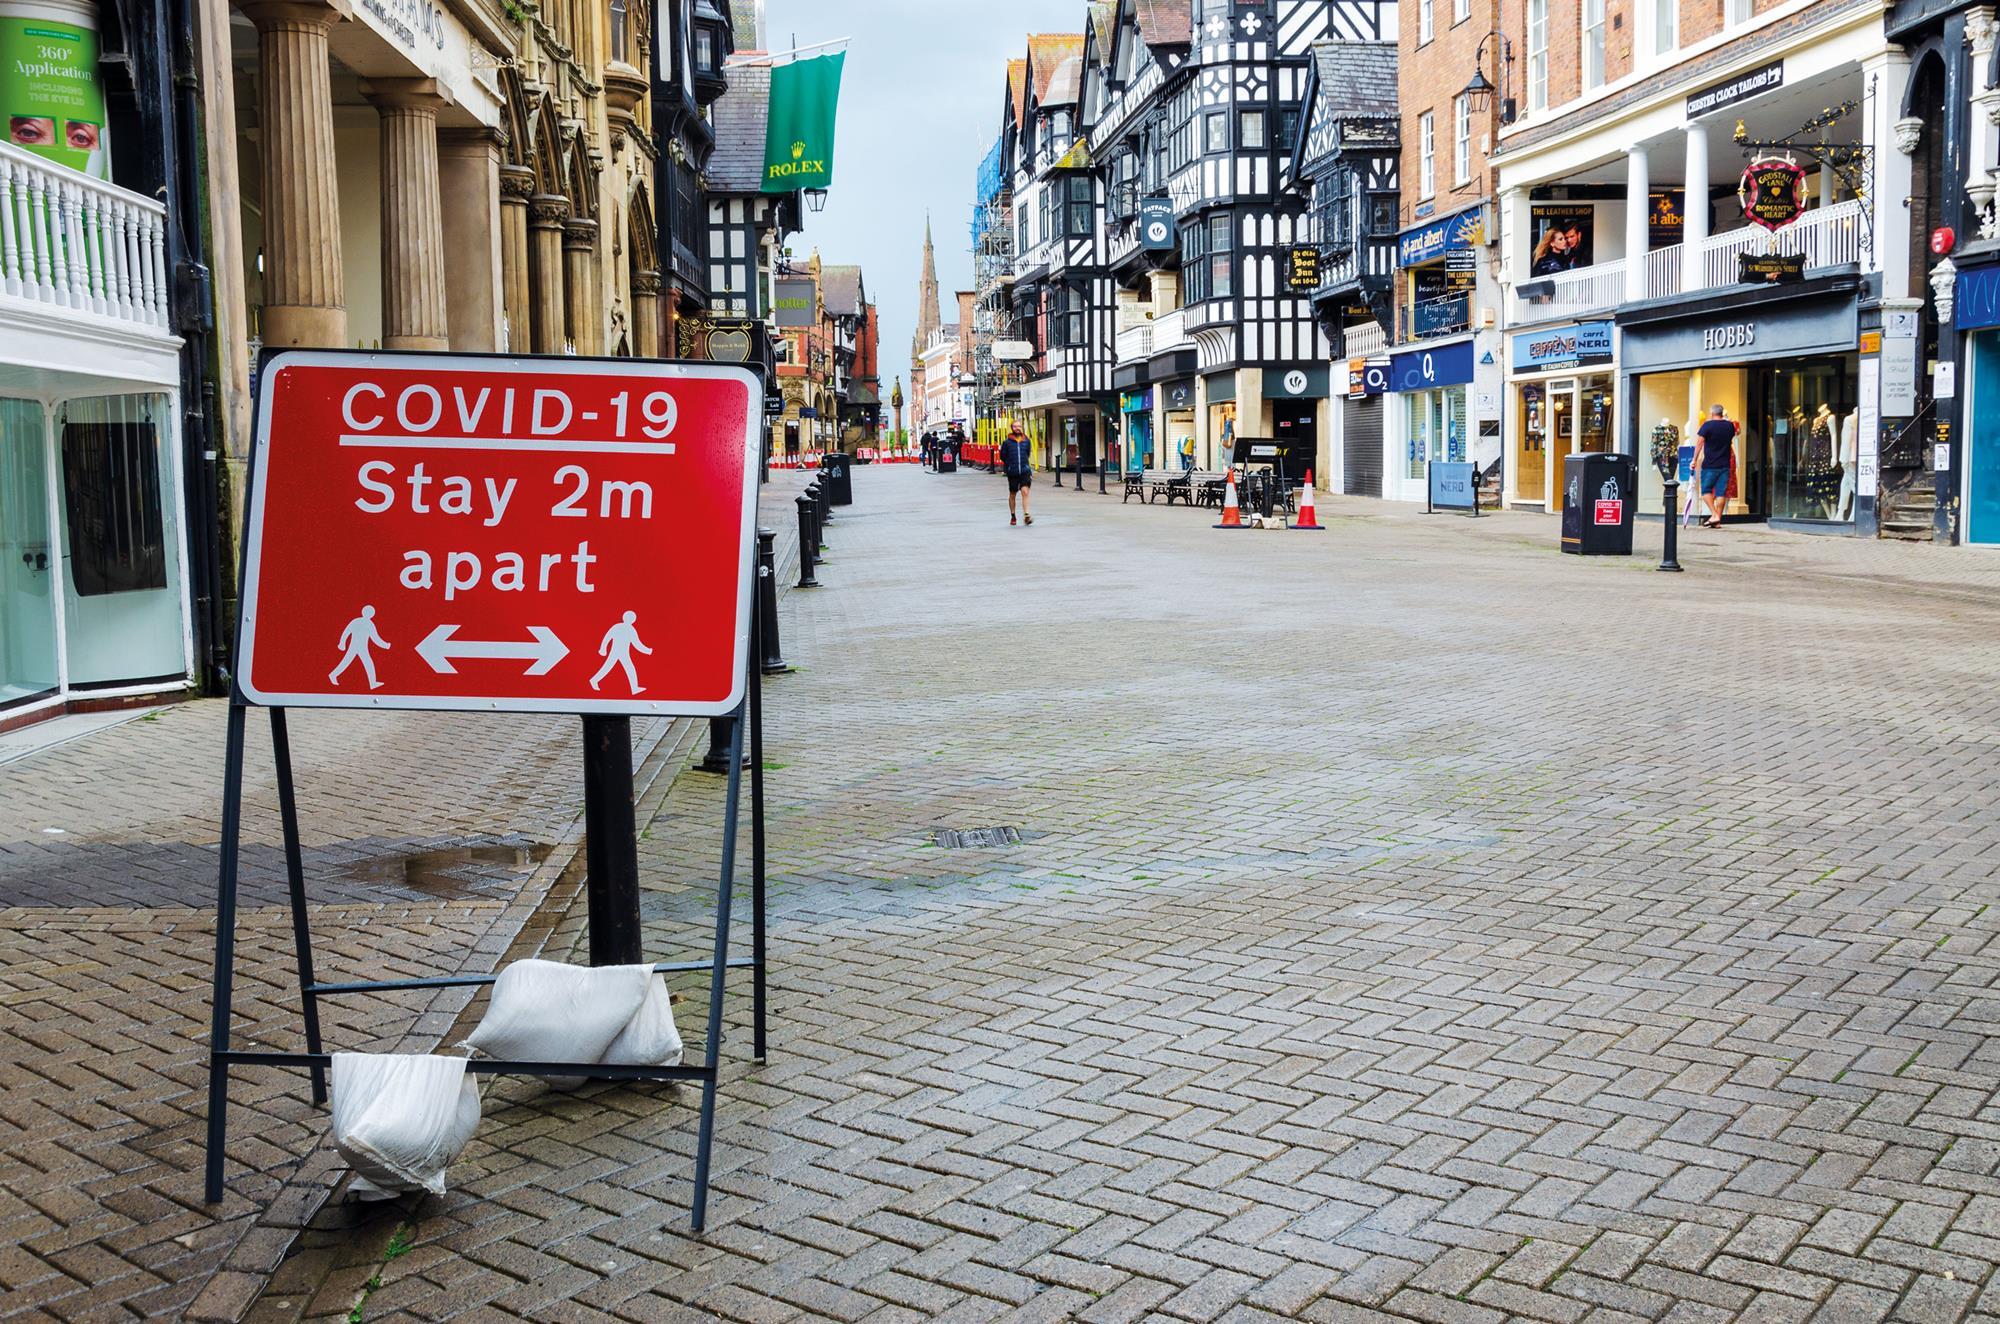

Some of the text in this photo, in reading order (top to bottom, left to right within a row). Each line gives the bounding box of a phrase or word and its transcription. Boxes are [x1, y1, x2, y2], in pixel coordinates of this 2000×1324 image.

[37, 45, 72, 61] 360°
[14, 60, 93, 81] Application
[1687, 72, 1767, 114] CHESTER CLOCK TAILORS
[769, 160, 824, 178] ROLEX
[1759, 171, 1792, 185] GODSTALL
[1767, 179, 1785, 187] LANE
[1143, 204, 1171, 214] FATFACE
[1533, 208, 1592, 216] THE LEATHER SHOP
[1756, 205, 1795, 213] ROMANTIC
[1764, 211, 1786, 219] HEART
[1424, 228, 1443, 247] albert
[1578, 339, 1610, 349] NERO
[1704, 323, 1755, 351] HOBBS
[1367, 369, 1387, 390] O2
[342, 382, 678, 439] COVID-19
[1861, 465, 1875, 476] ZEN
[354, 460, 653, 527] Stay 2m
[1441, 482, 1464, 492] NERO
[399, 540, 597, 601] apart
